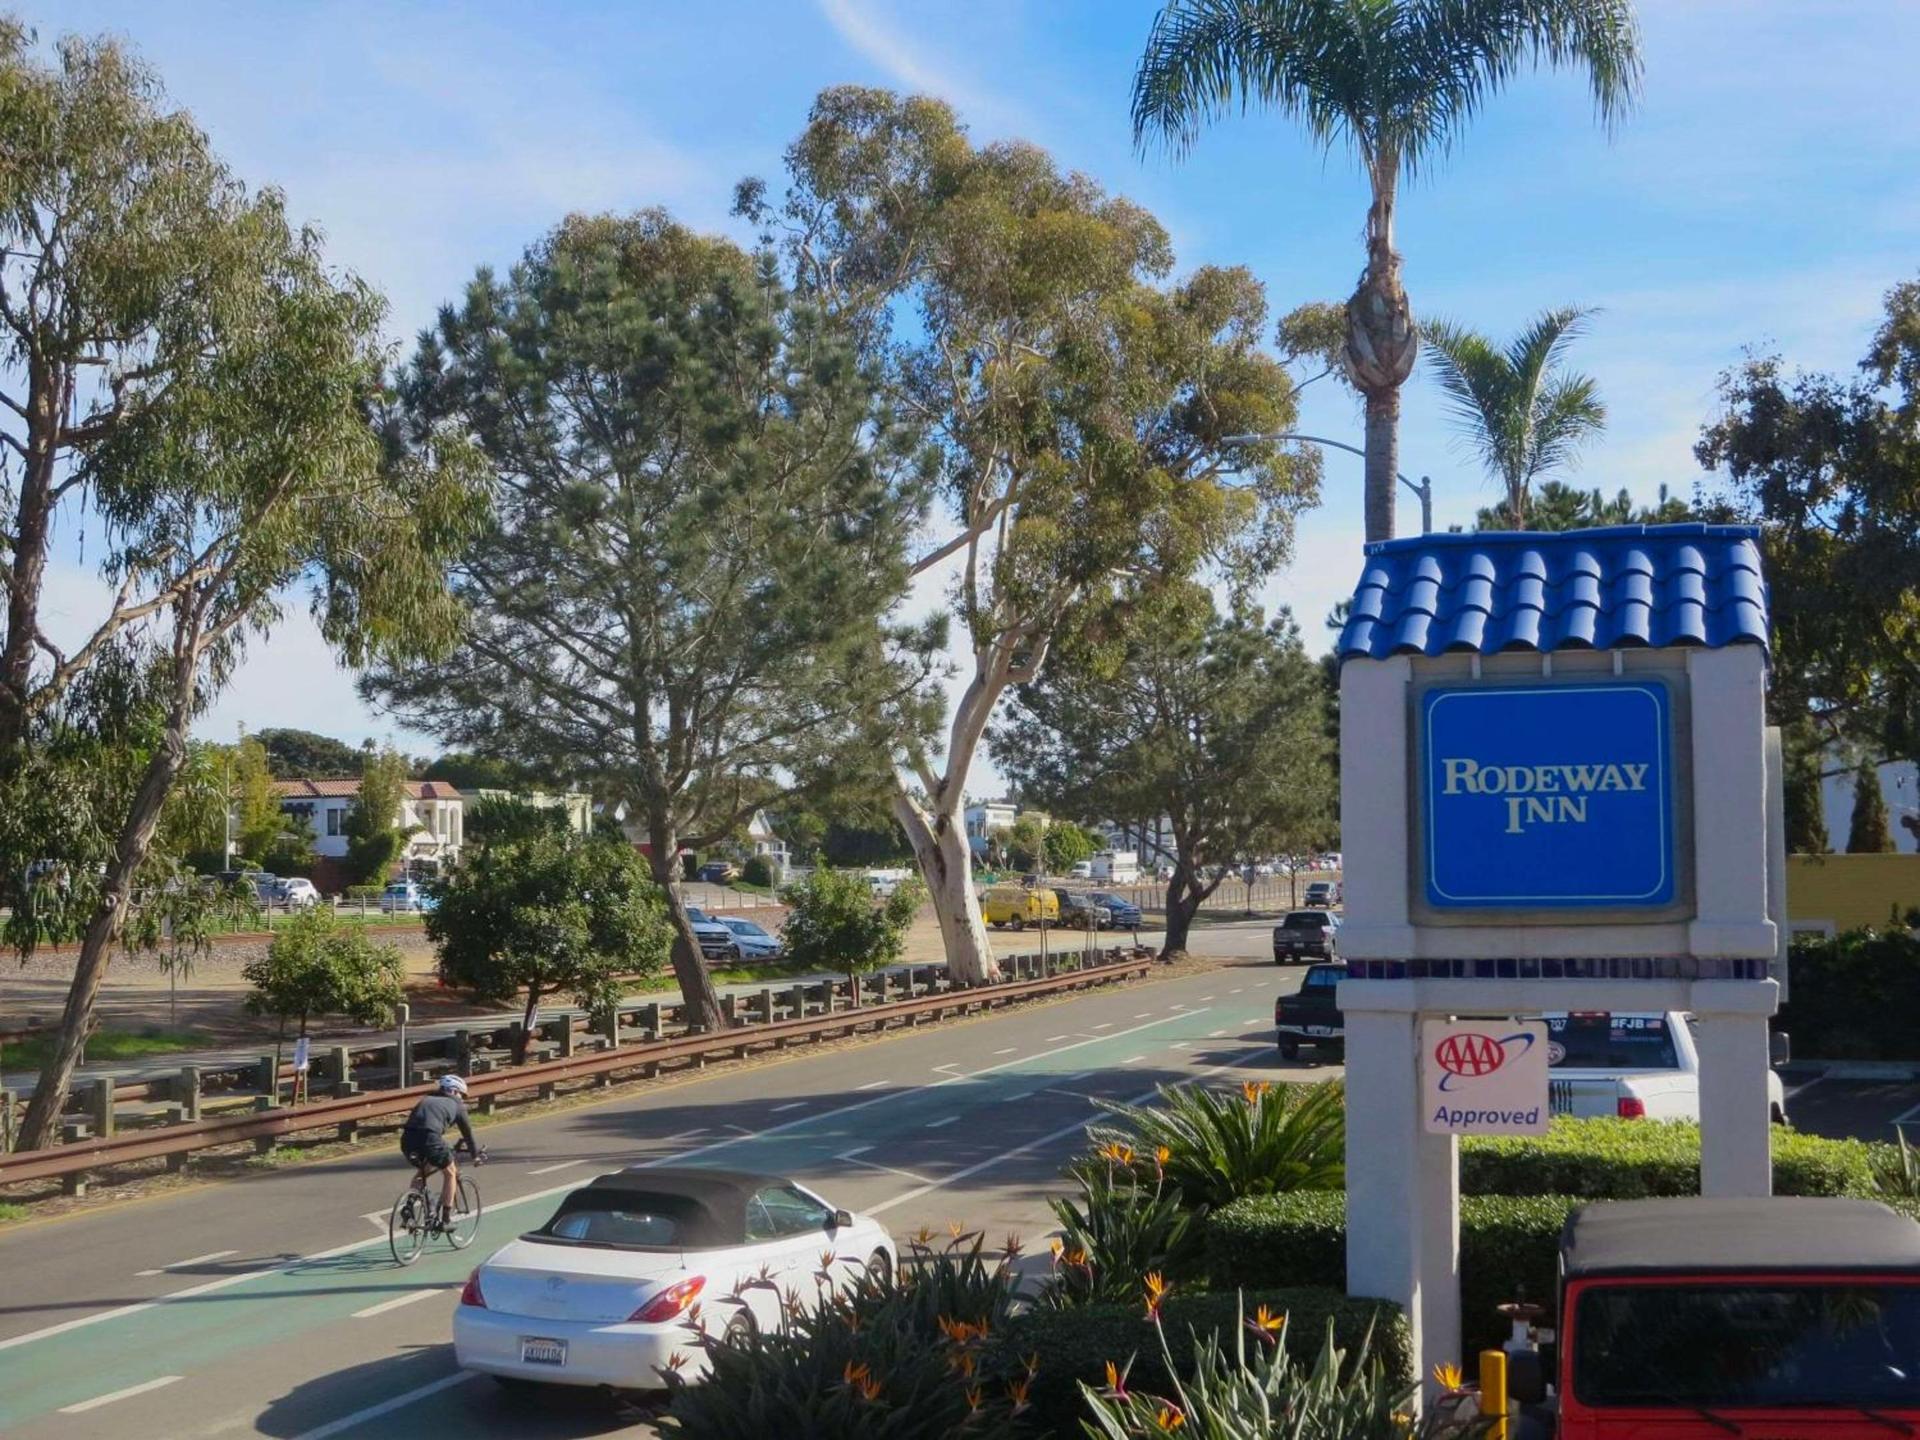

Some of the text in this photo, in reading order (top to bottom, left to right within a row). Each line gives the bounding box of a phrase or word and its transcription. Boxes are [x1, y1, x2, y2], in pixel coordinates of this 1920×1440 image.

[1441, 757, 1649, 795] RODEWAY
[1504, 796, 1588, 834] INN
[1442, 1034, 1500, 1076] AAA
[1433, 1105, 1539, 1128] Approved
